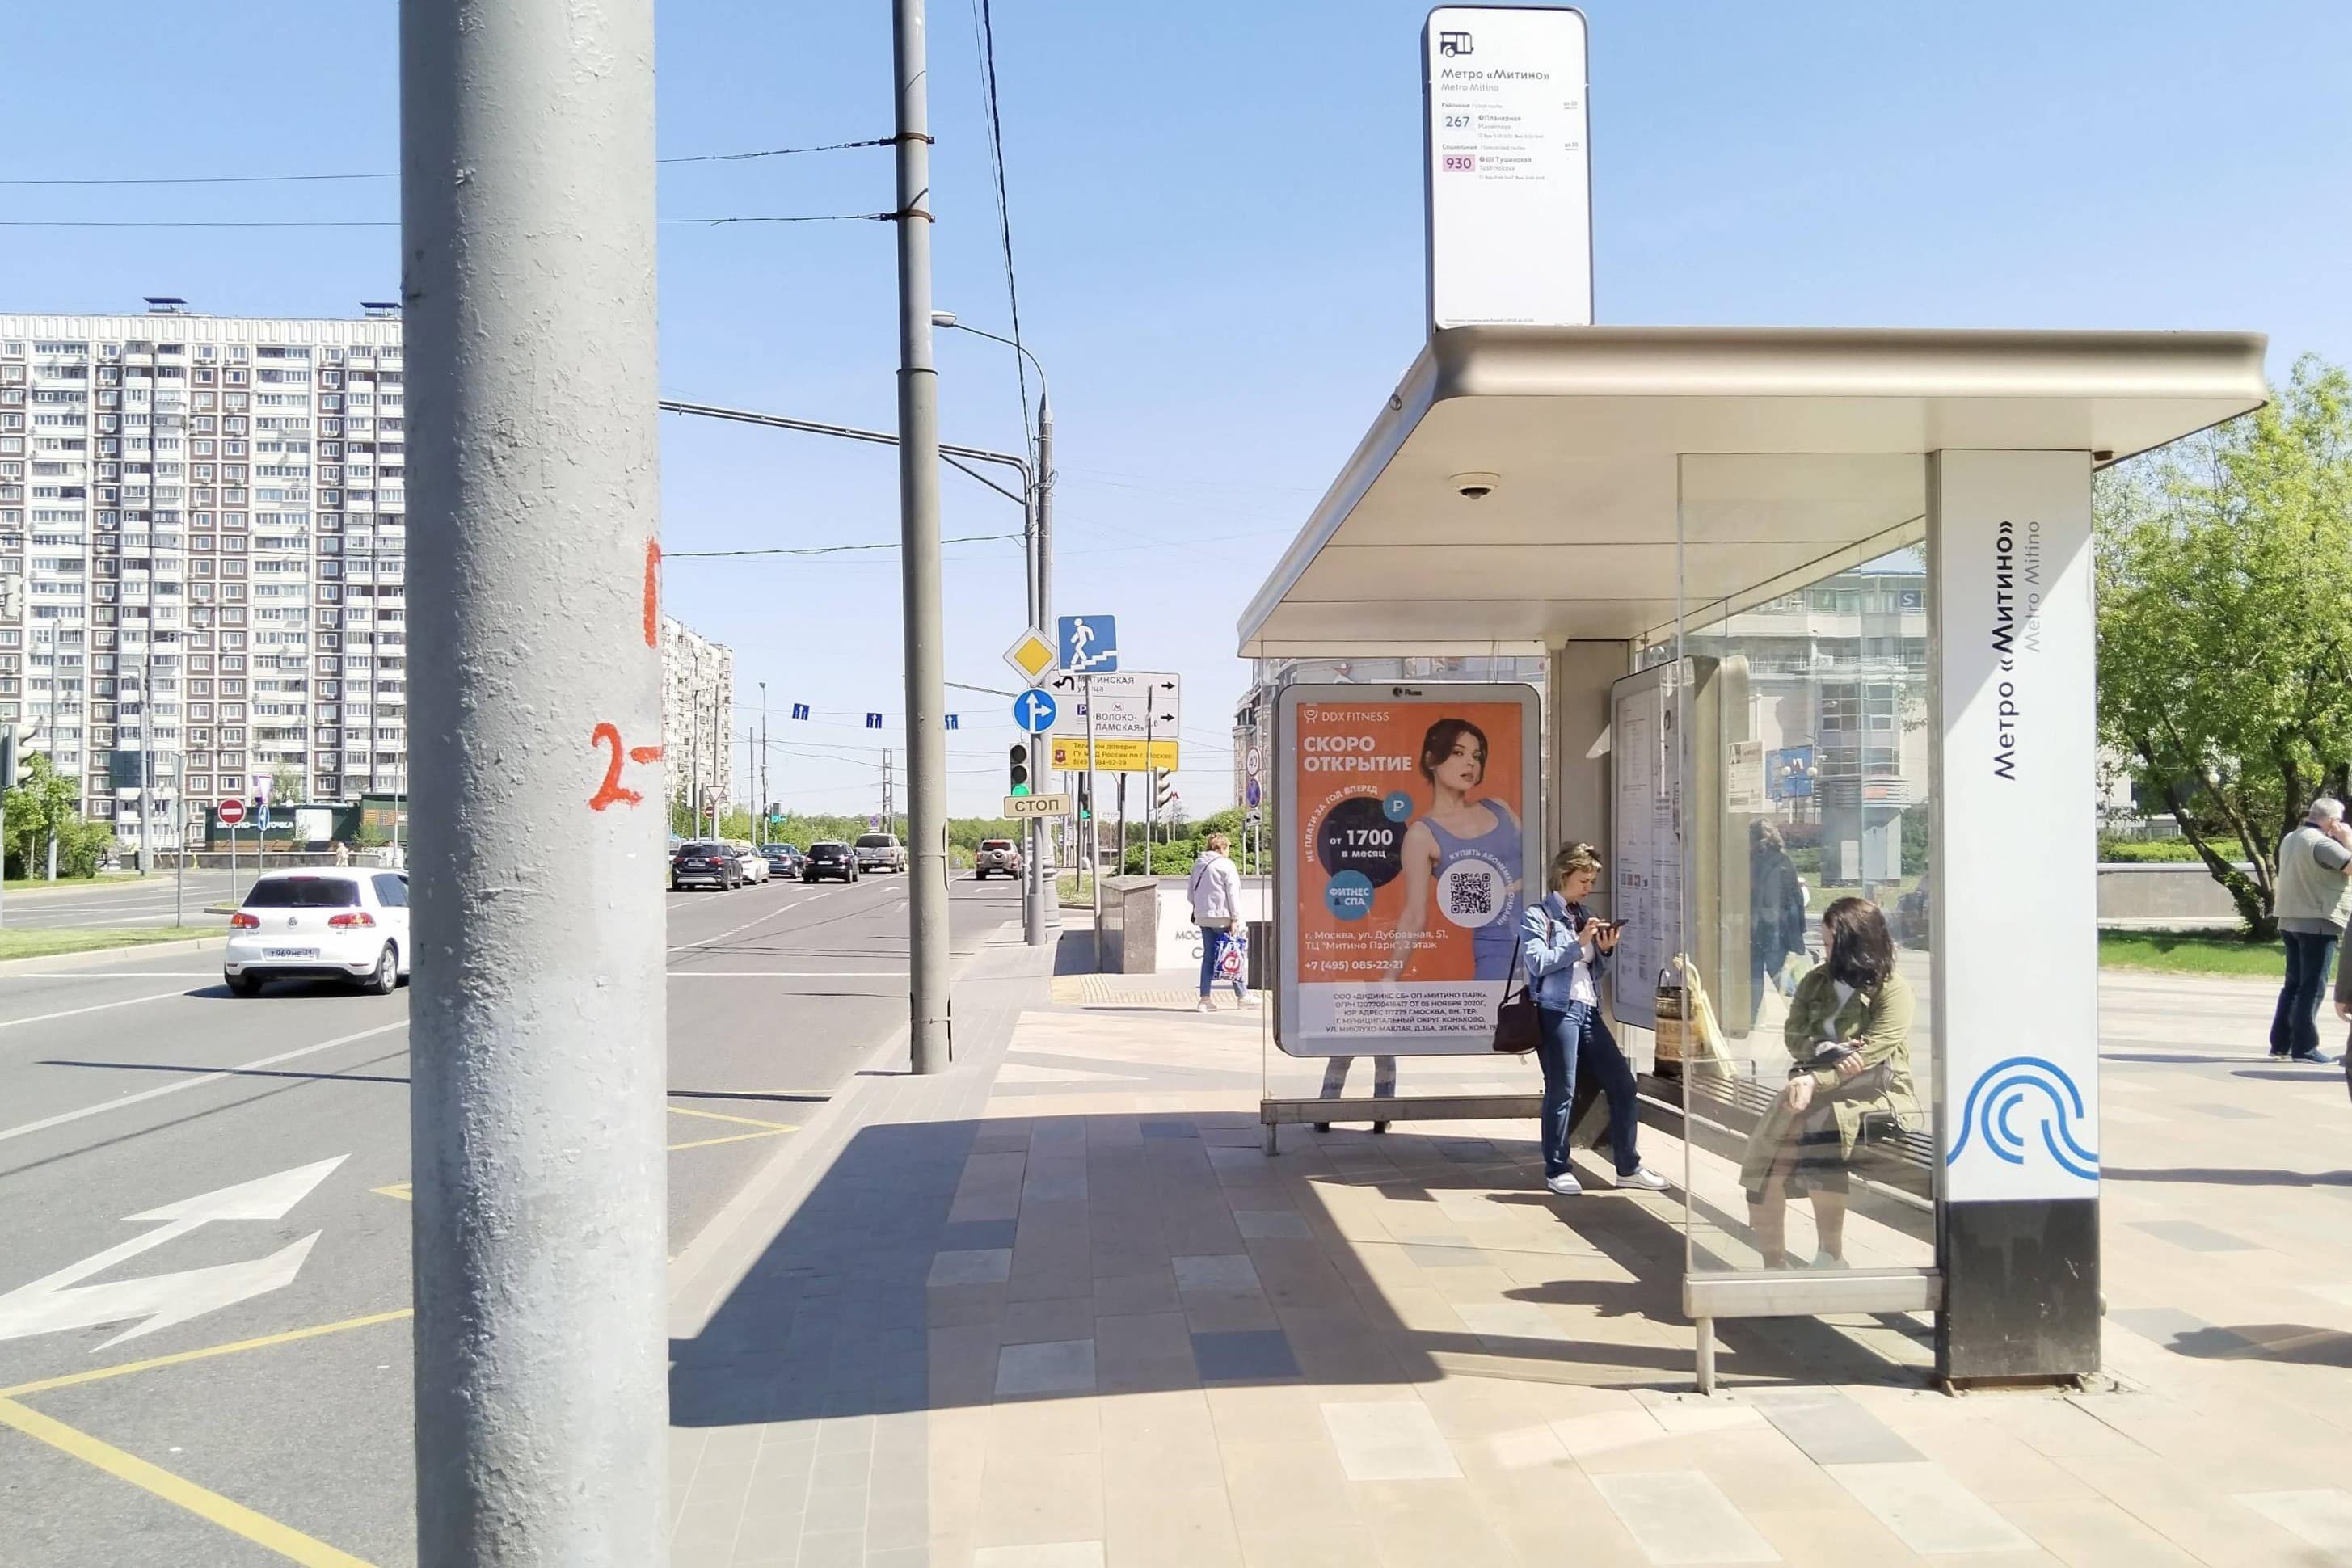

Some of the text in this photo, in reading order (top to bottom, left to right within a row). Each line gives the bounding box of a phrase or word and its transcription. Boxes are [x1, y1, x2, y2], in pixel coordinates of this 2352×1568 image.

[1440, 68, 1550, 81] Метро «Митино»
[1440, 83, 1499, 91] Metro Mitino
[1445, 116, 1470, 128] 267
[1446, 158, 1472, 169] 930
[2024, 521, 2041, 653] Metro Mitino
[1991, 520, 2020, 781] Метро «Митино»
[1077, 675, 1135, 685] МТИНСКАЯ
[1077, 685, 1104, 693] улца
[1321, 711, 1389, 722] DDX FITNESS
[1303, 736, 1376, 752] СКОРО
[1249, 756, 1258, 767] 40
[1304, 756, 1413, 772] ОТКРЫТИЕ
[1326, 790, 1343, 805] ГОД
[1014, 799, 1060, 812] СТОП
[1347, 829, 1393, 846] 1700
[1351, 850, 1387, 860] месяц
[1329, 887, 1370, 896] ФИТНЕС
[1344, 897, 1366, 906] СПА
[1314, 931, 1356, 940] Москва,
[1358, 932, 1373, 941] ул.
[1375, 930, 1434, 941] Дубравная,
[1305, 942, 1320, 950] ТЦ
[1305, 960, 1404, 972] +7 (495) 085-22-21
